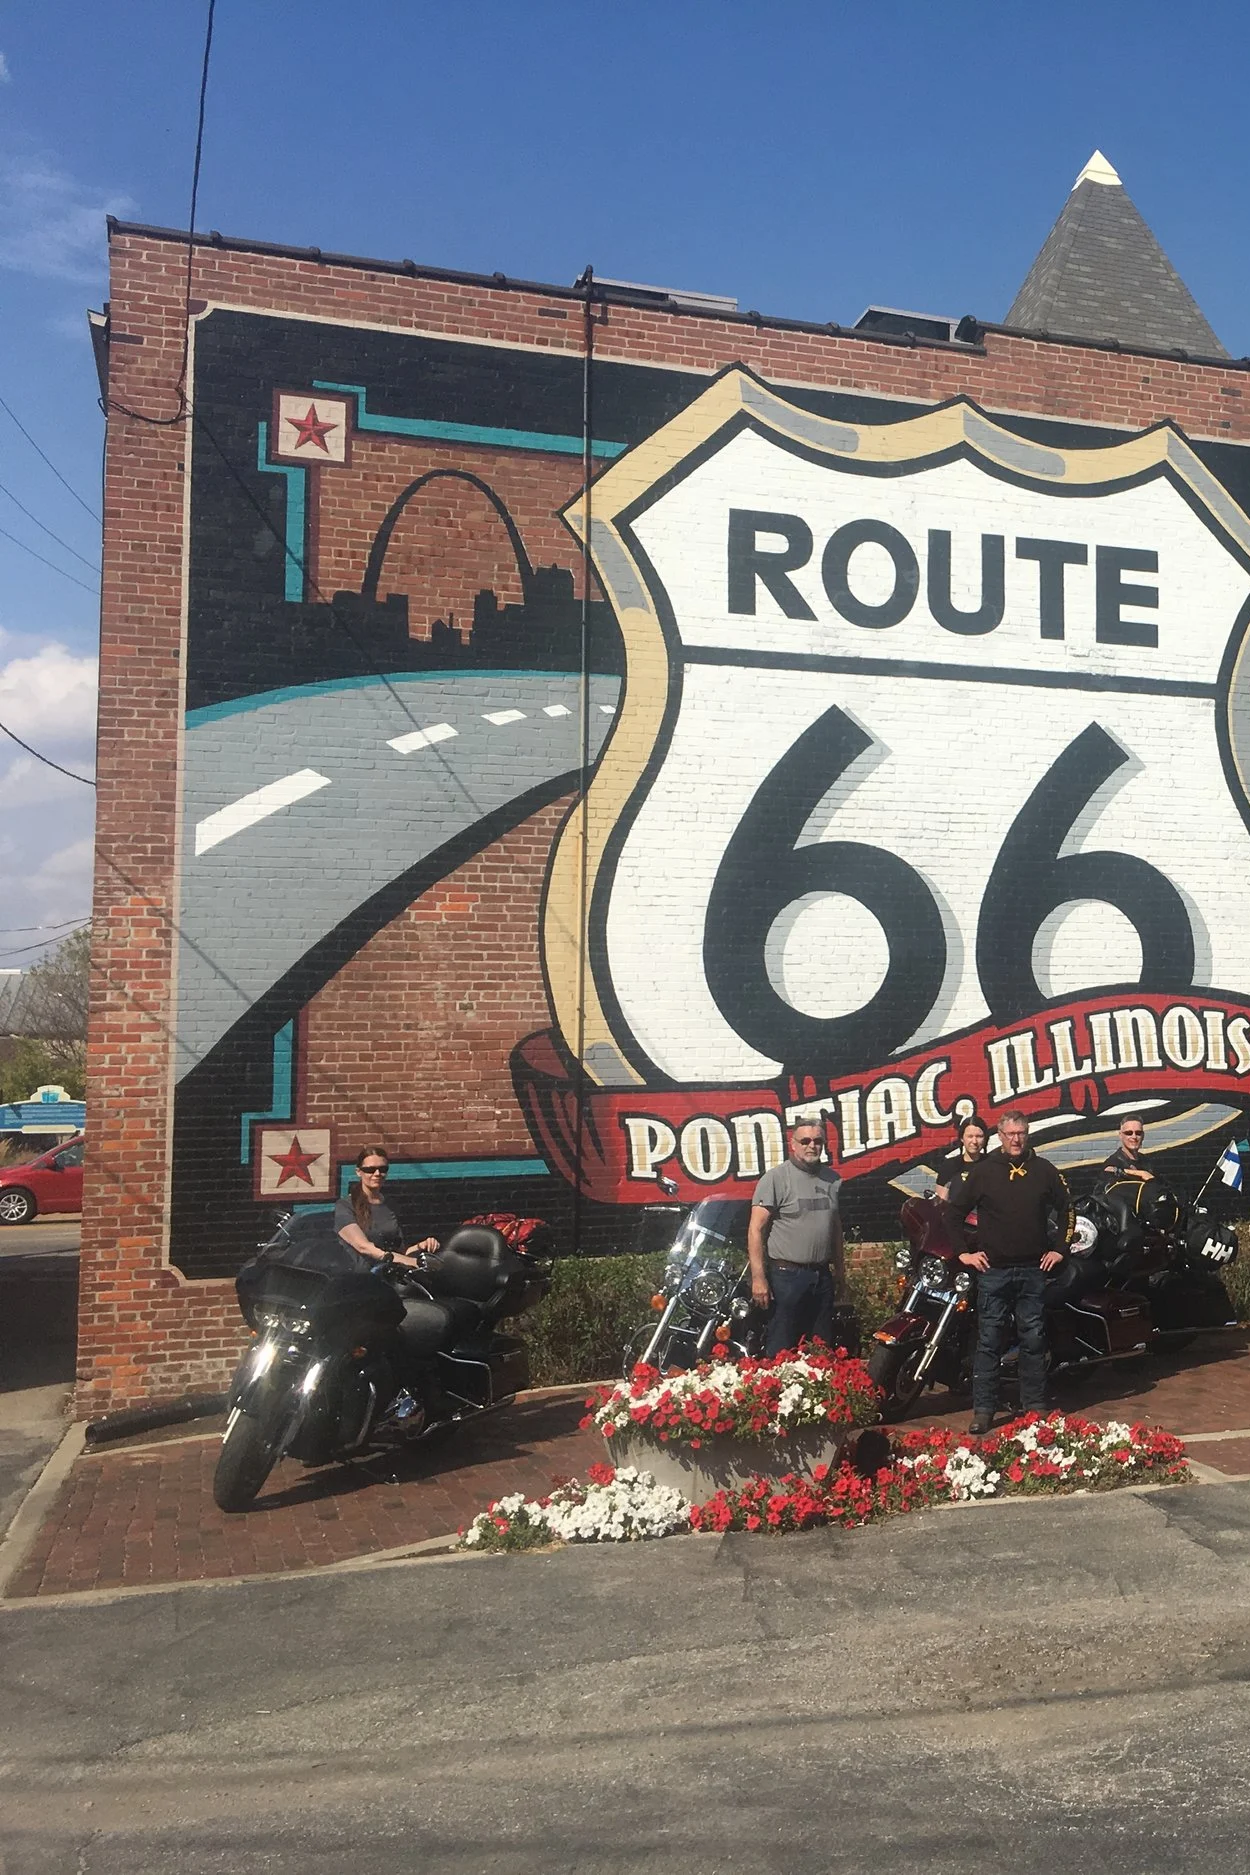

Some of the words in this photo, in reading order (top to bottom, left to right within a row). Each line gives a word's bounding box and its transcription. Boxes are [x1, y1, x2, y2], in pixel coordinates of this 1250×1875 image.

[727, 507, 1160, 649] ROUTE
[702, 703, 1197, 1071] 66
[1200, 1237, 1234, 1264] HH
